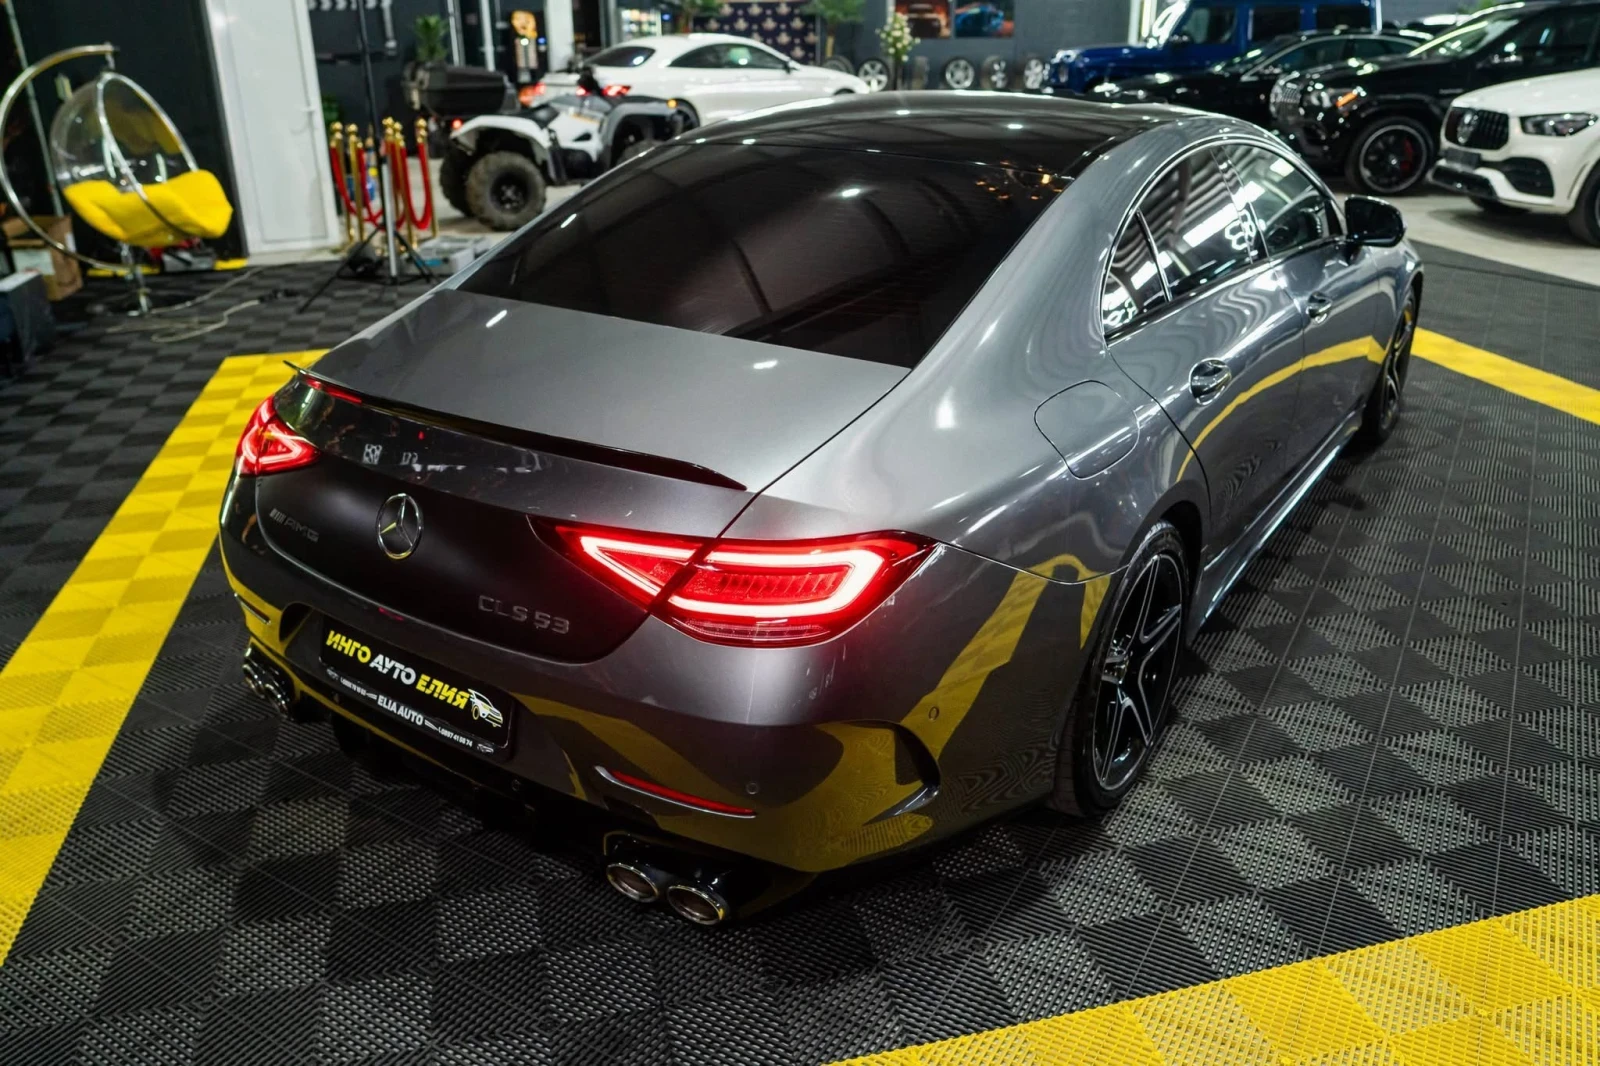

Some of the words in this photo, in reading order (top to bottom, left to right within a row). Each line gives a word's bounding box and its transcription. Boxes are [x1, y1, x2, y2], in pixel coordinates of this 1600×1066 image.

[283, 516, 320, 543] AMG
[478, 594, 528, 622] CLS
[533, 611, 570, 635] 53
[326, 629, 372, 664] ИНГО
[369, 654, 417, 686] АУТО
[415, 673, 470, 710] ЕЛИЯ
[377, 694, 397, 714] ELIA
[397, 705, 424, 726] AUTO
